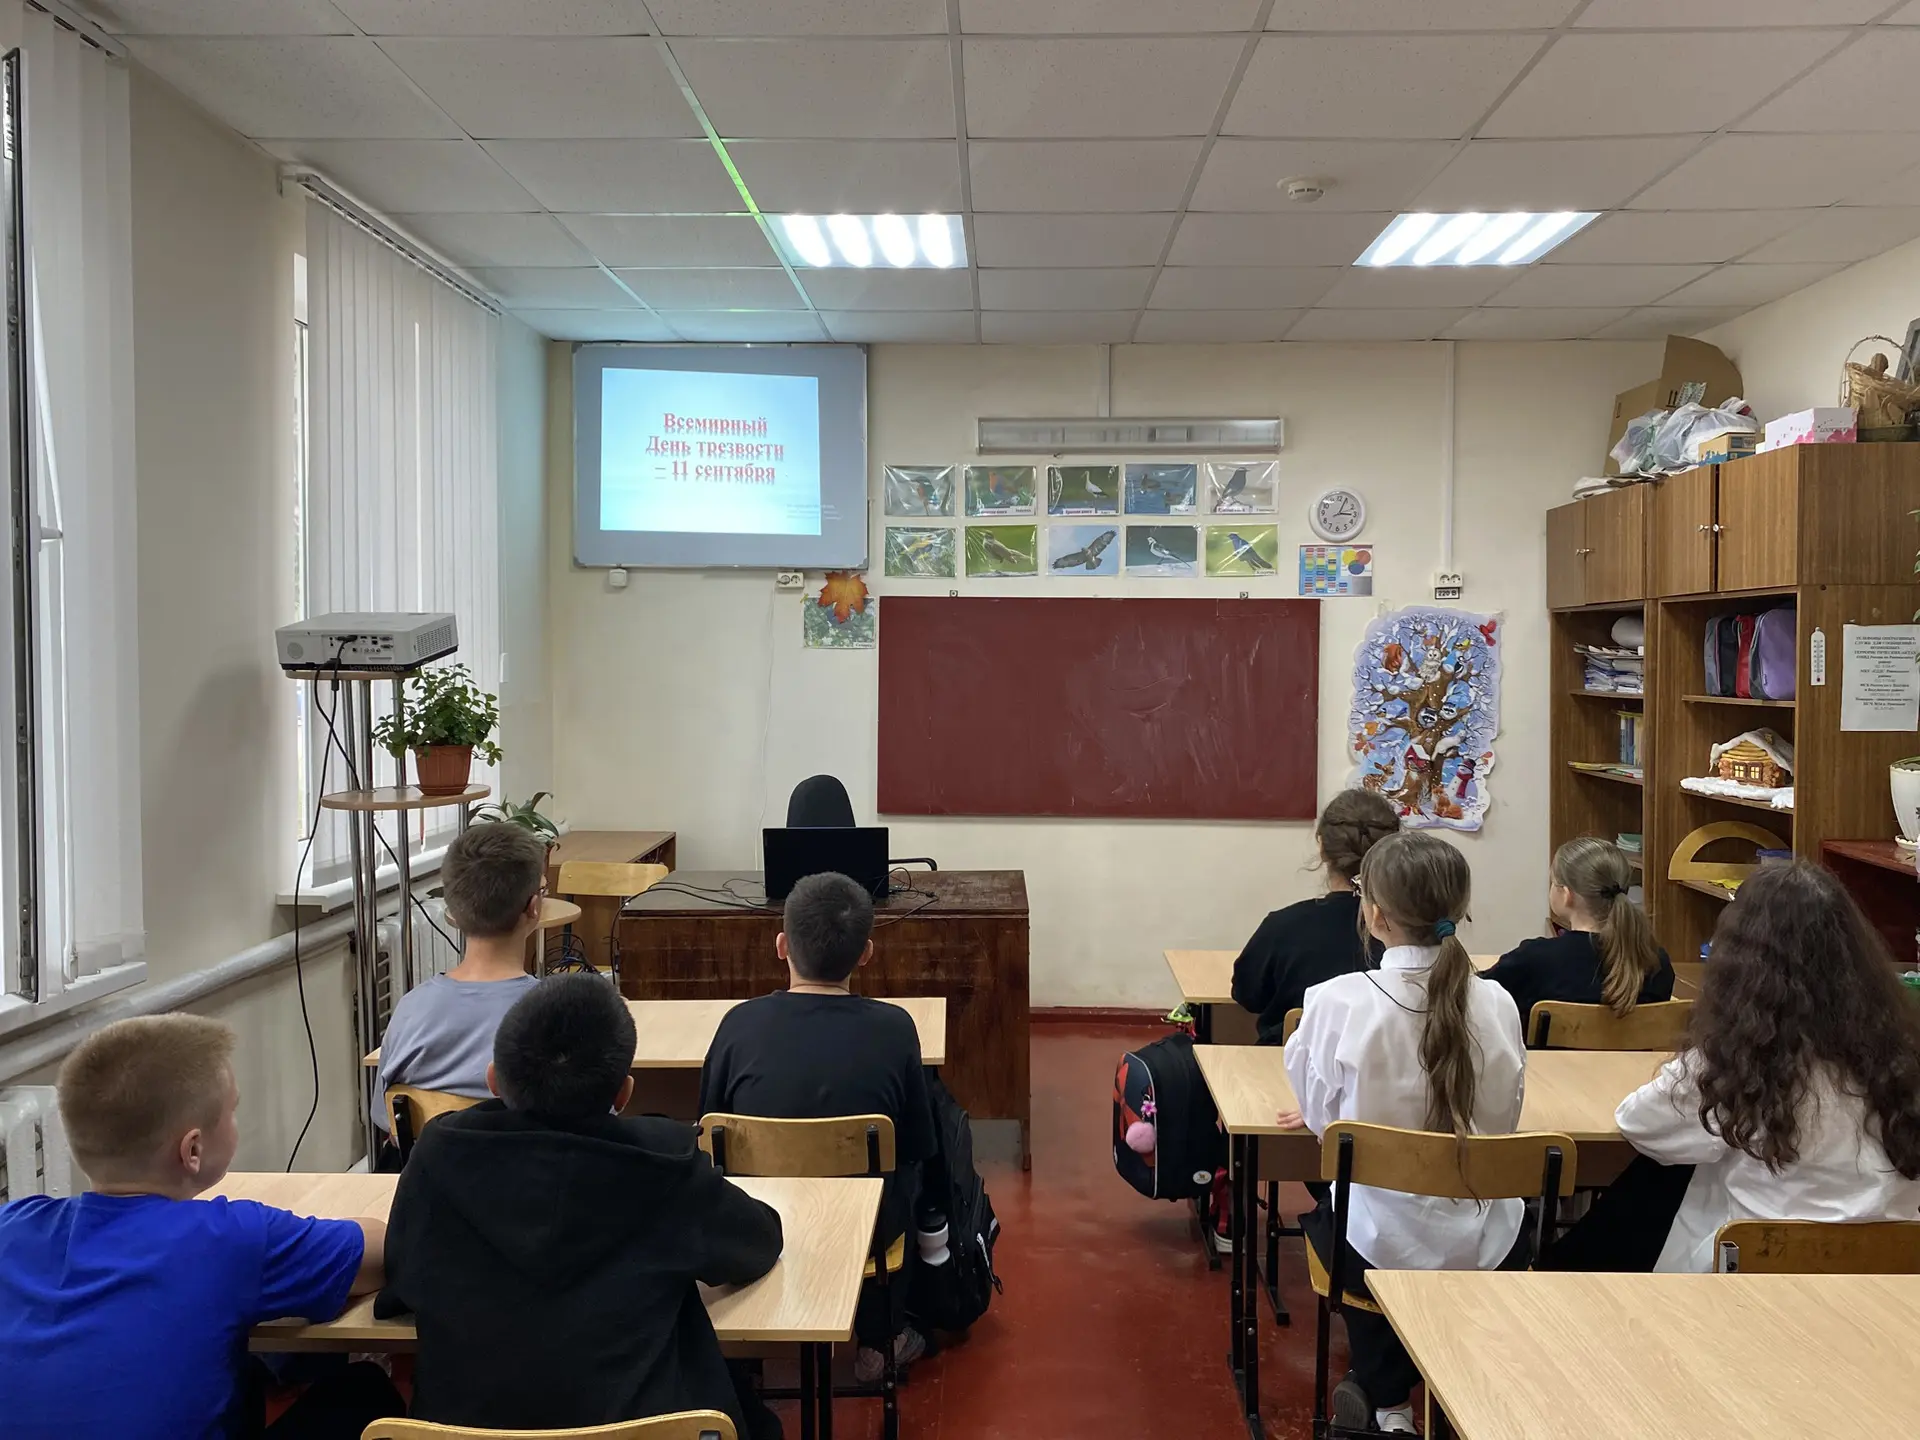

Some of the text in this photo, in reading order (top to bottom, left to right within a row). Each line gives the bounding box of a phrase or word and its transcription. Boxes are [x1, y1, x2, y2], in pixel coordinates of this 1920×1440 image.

[663, 412, 768, 435] Всемирный
[646, 435, 784, 458] День трезвости
[672, 460, 688, 476] 11
[695, 463, 775, 483] сентября
